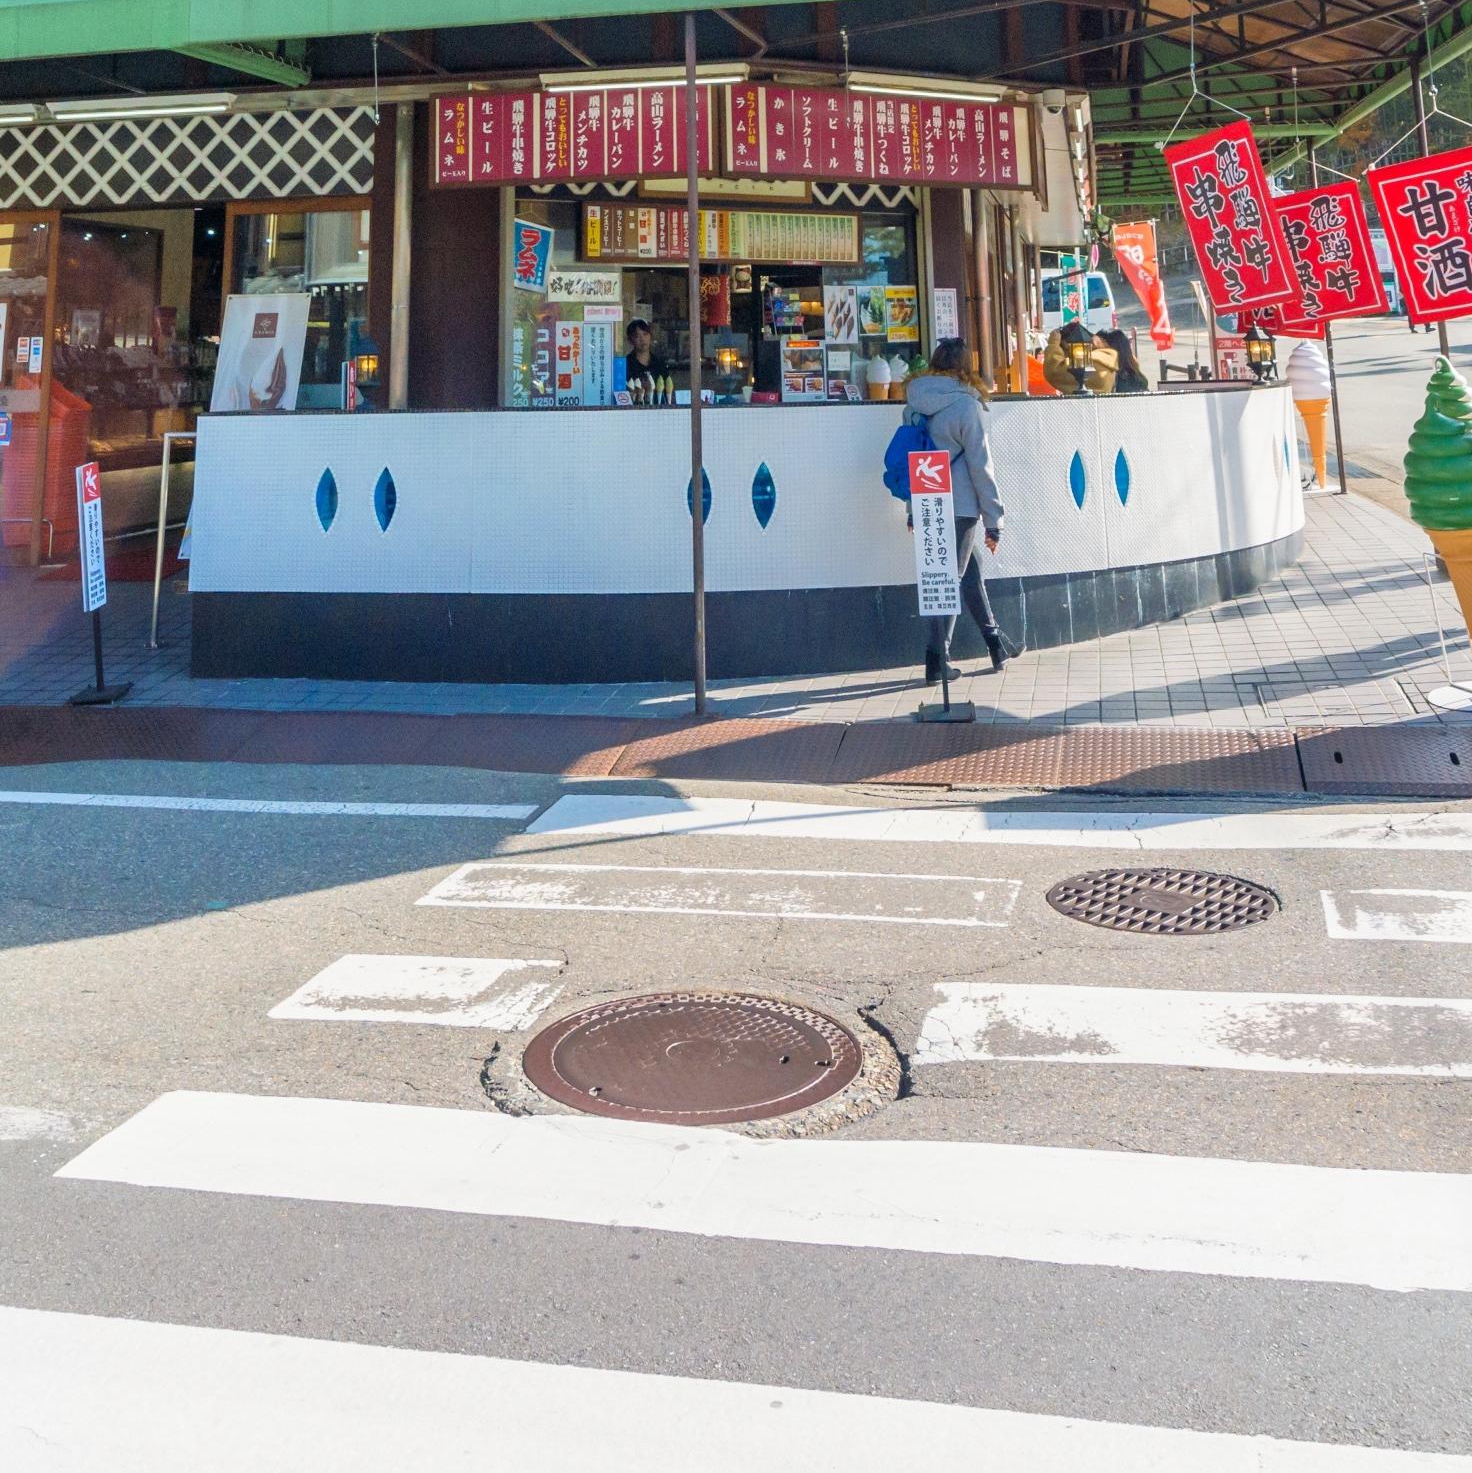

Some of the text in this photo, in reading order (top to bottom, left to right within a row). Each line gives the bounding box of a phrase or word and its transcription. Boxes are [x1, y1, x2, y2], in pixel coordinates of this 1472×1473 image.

[444, 109, 454, 166] ラムネ
[456, 102, 465, 155] なつかしい味
[481, 101, 494, 174] 生ビール
[558, 97, 568, 167] とってもおいしい
[576, 110, 588, 171] メンチカツ
[611, 107, 623, 168] カレーパン
[651, 92, 664, 167] 高山ラーメン
[736, 97, 747, 155] ラムネ
[747, 91, 756, 144] なつかしい味
[774, 97, 786, 161] かき氷
[802, 96, 812, 169] ソフトクリーム
[828, 98, 839, 169] 生ビール
[911, 104, 921, 171] とってもおいしい
[924, 119, 935, 176] メンチカツ
[948, 119, 959, 175] カレーパン
[974, 109, 987, 177] 高山ラーメン
[516, 228, 542, 280] ラムネ
[590, 209, 598, 244] 生ビール
[1184, 166, 1245, 304] 串焼き
[558, 397, 580, 406] ¥200
[921, 499, 934, 566] ご注意ください
[934, 498, 947, 566] 滑りやすいので
